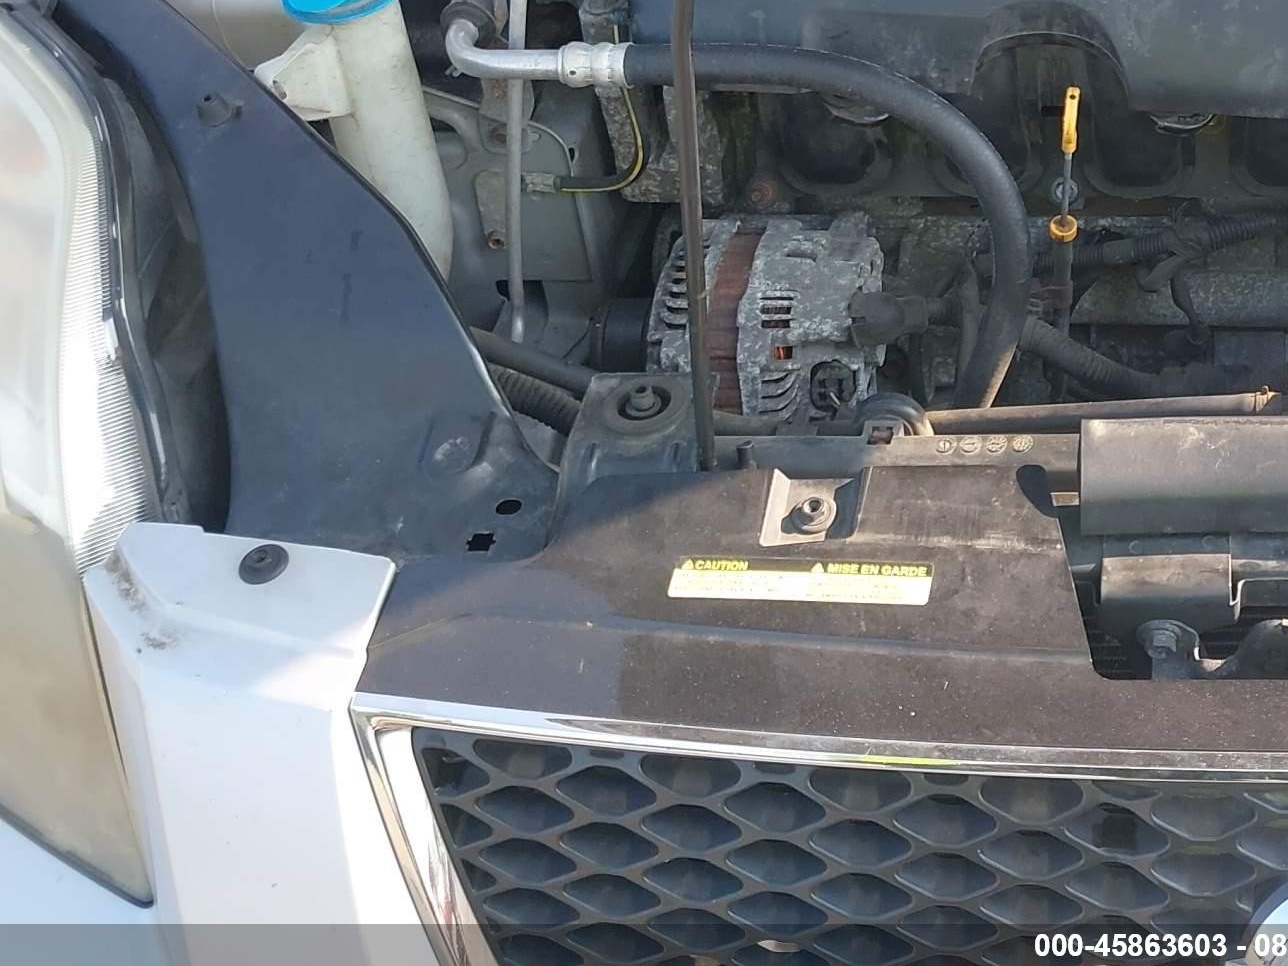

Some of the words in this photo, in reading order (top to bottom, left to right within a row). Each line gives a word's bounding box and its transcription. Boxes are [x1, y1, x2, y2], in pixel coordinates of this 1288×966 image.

[694, 559, 749, 571] CAUTION
[827, 562, 860, 574] MISE
[860, 564, 880, 575] EN
[881, 565, 928, 577] GARDE
